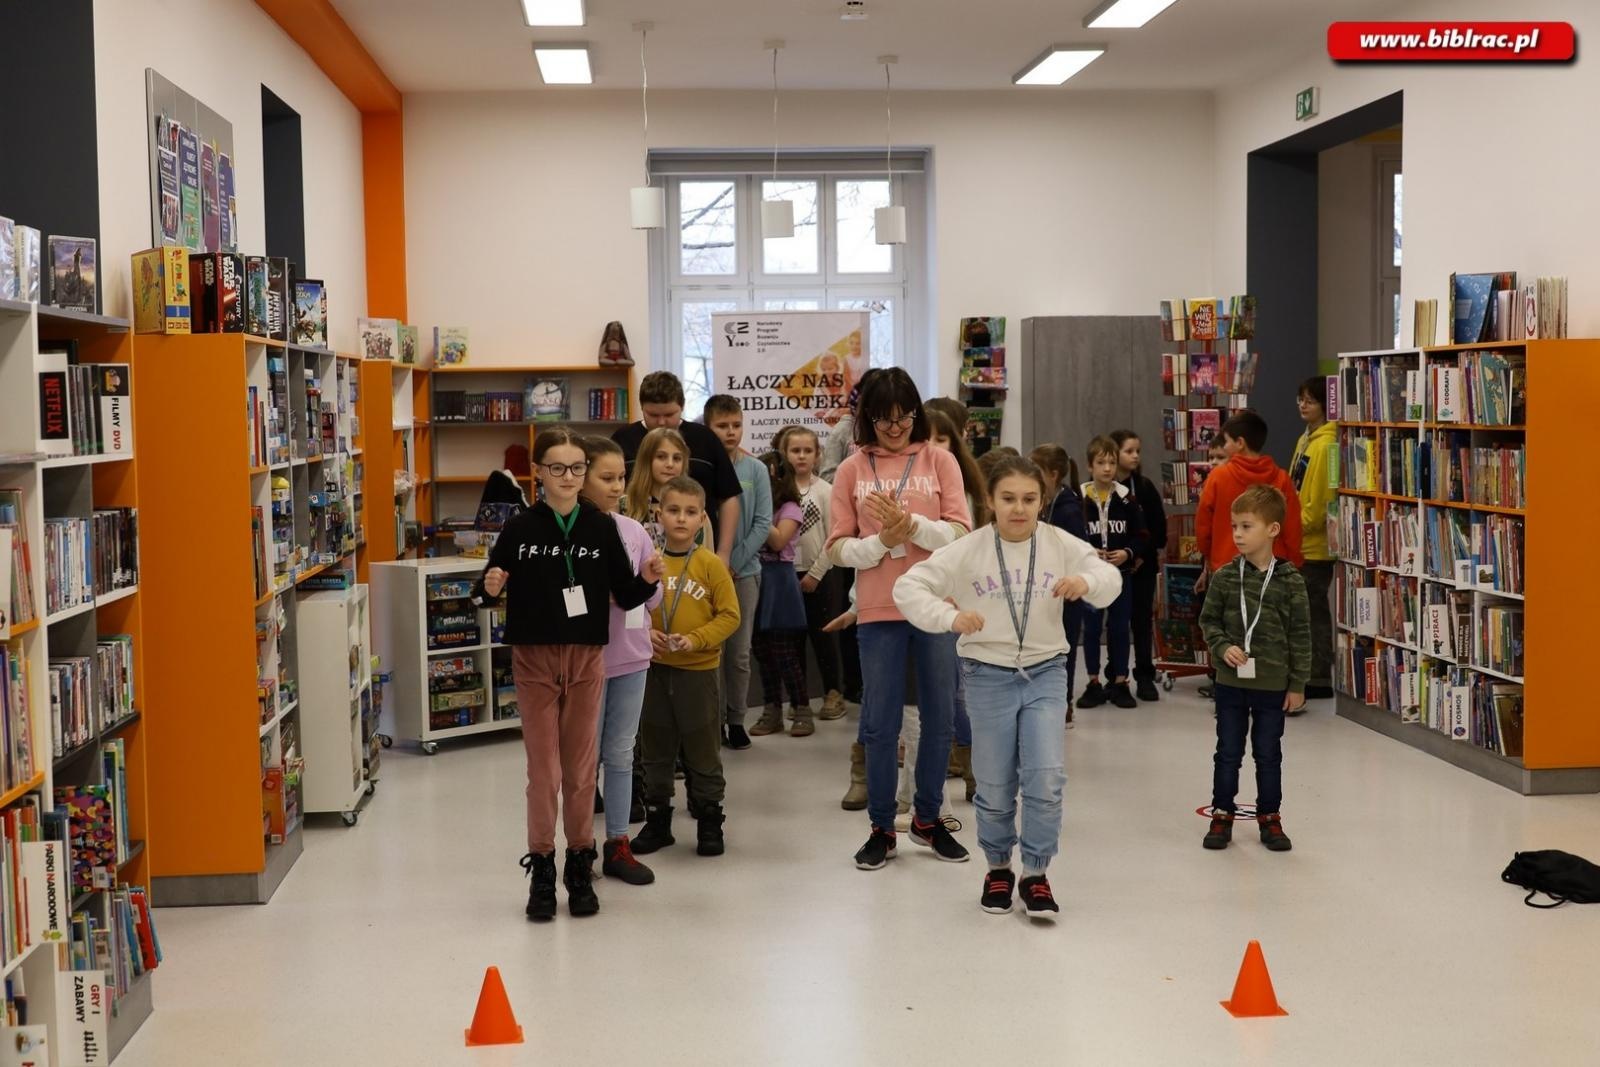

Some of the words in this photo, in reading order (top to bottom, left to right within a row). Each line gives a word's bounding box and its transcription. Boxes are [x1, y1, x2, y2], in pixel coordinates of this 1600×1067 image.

[223, 256, 231, 290] WARS
[728, 374, 796, 392] ŁĄCZY
[802, 373, 844, 388] NAS
[44, 378, 63, 433] NETFLIX
[112, 397, 120, 427] FILMY
[783, 417, 800, 425] NAS
[113, 430, 121, 450] DVD
[752, 432, 775, 440] ŁĄCZ
[857, 475, 934, 499] BROOLYN
[1366, 528, 1374, 562] MUZYKA
[667, 576, 705, 600] KND
[1432, 609, 1440, 639] PIRACI
[44, 843, 55, 872] PARKI
[46, 873, 58, 930] NARODOWE
[74, 976, 85, 1023] ZABAWY
[90, 984, 101, 1007] GRY
